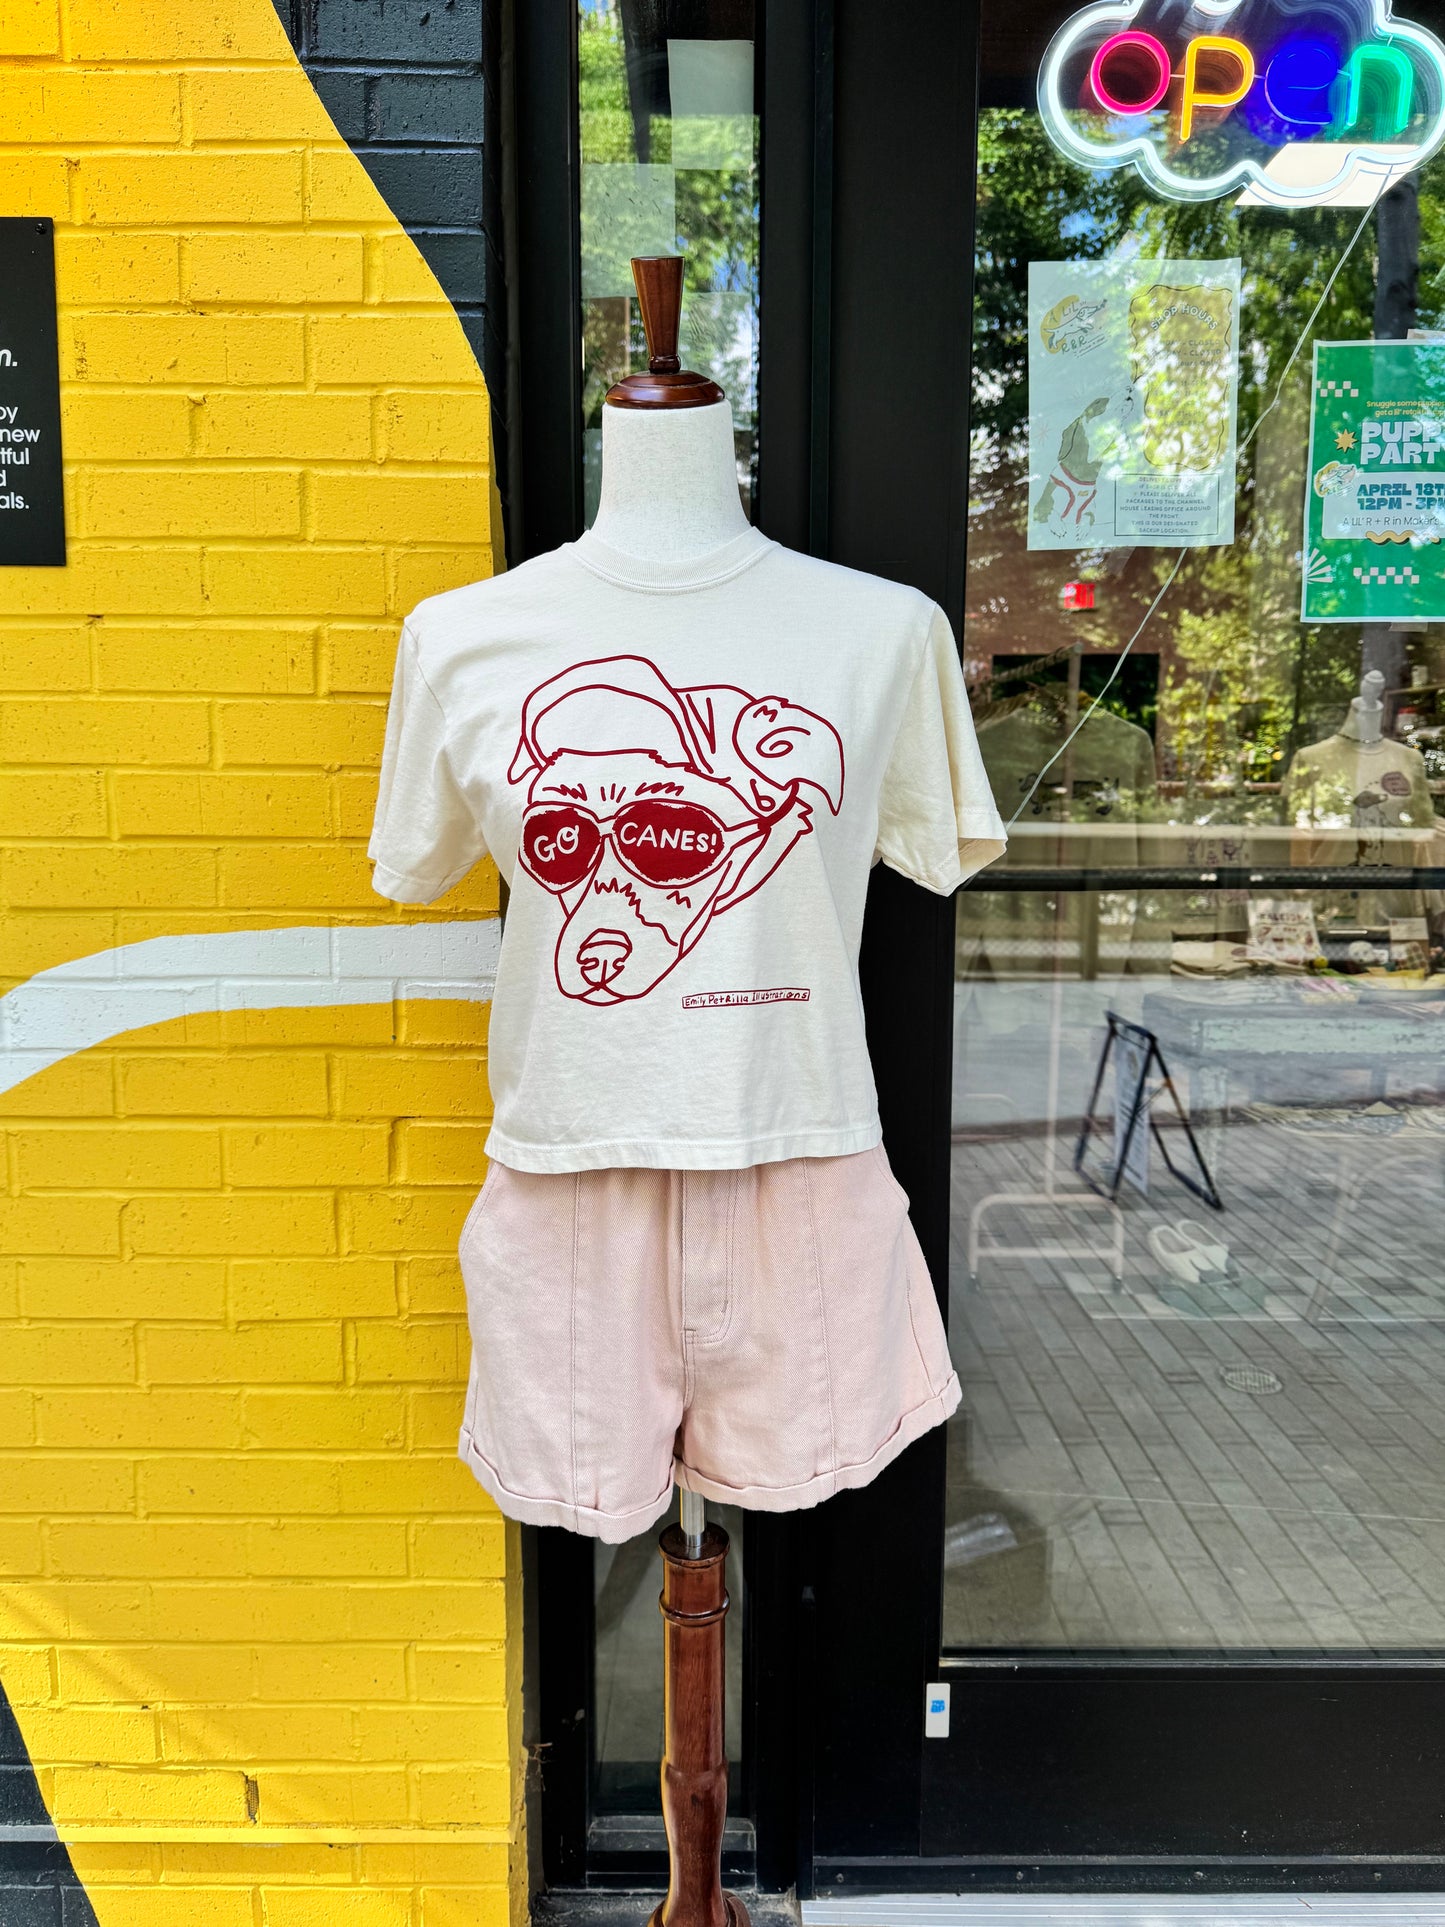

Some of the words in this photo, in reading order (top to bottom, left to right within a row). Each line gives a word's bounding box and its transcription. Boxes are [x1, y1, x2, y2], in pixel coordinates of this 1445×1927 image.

[1150, 306, 1178, 331] SHOP
[1181, 303, 1218, 330] HOURS
[0, 428, 41, 443] new
[1361, 421, 1445, 443] PUPP
[1360, 442, 1445, 464] PART
[1357, 483, 1412, 496] APRIL
[1415, 483, 1445, 496] 18T
[1357, 497, 1402, 510] 12PM
[533, 824, 580, 863] GO
[619, 821, 719, 854] CANES!
[685, 997, 706, 1007] Emily
